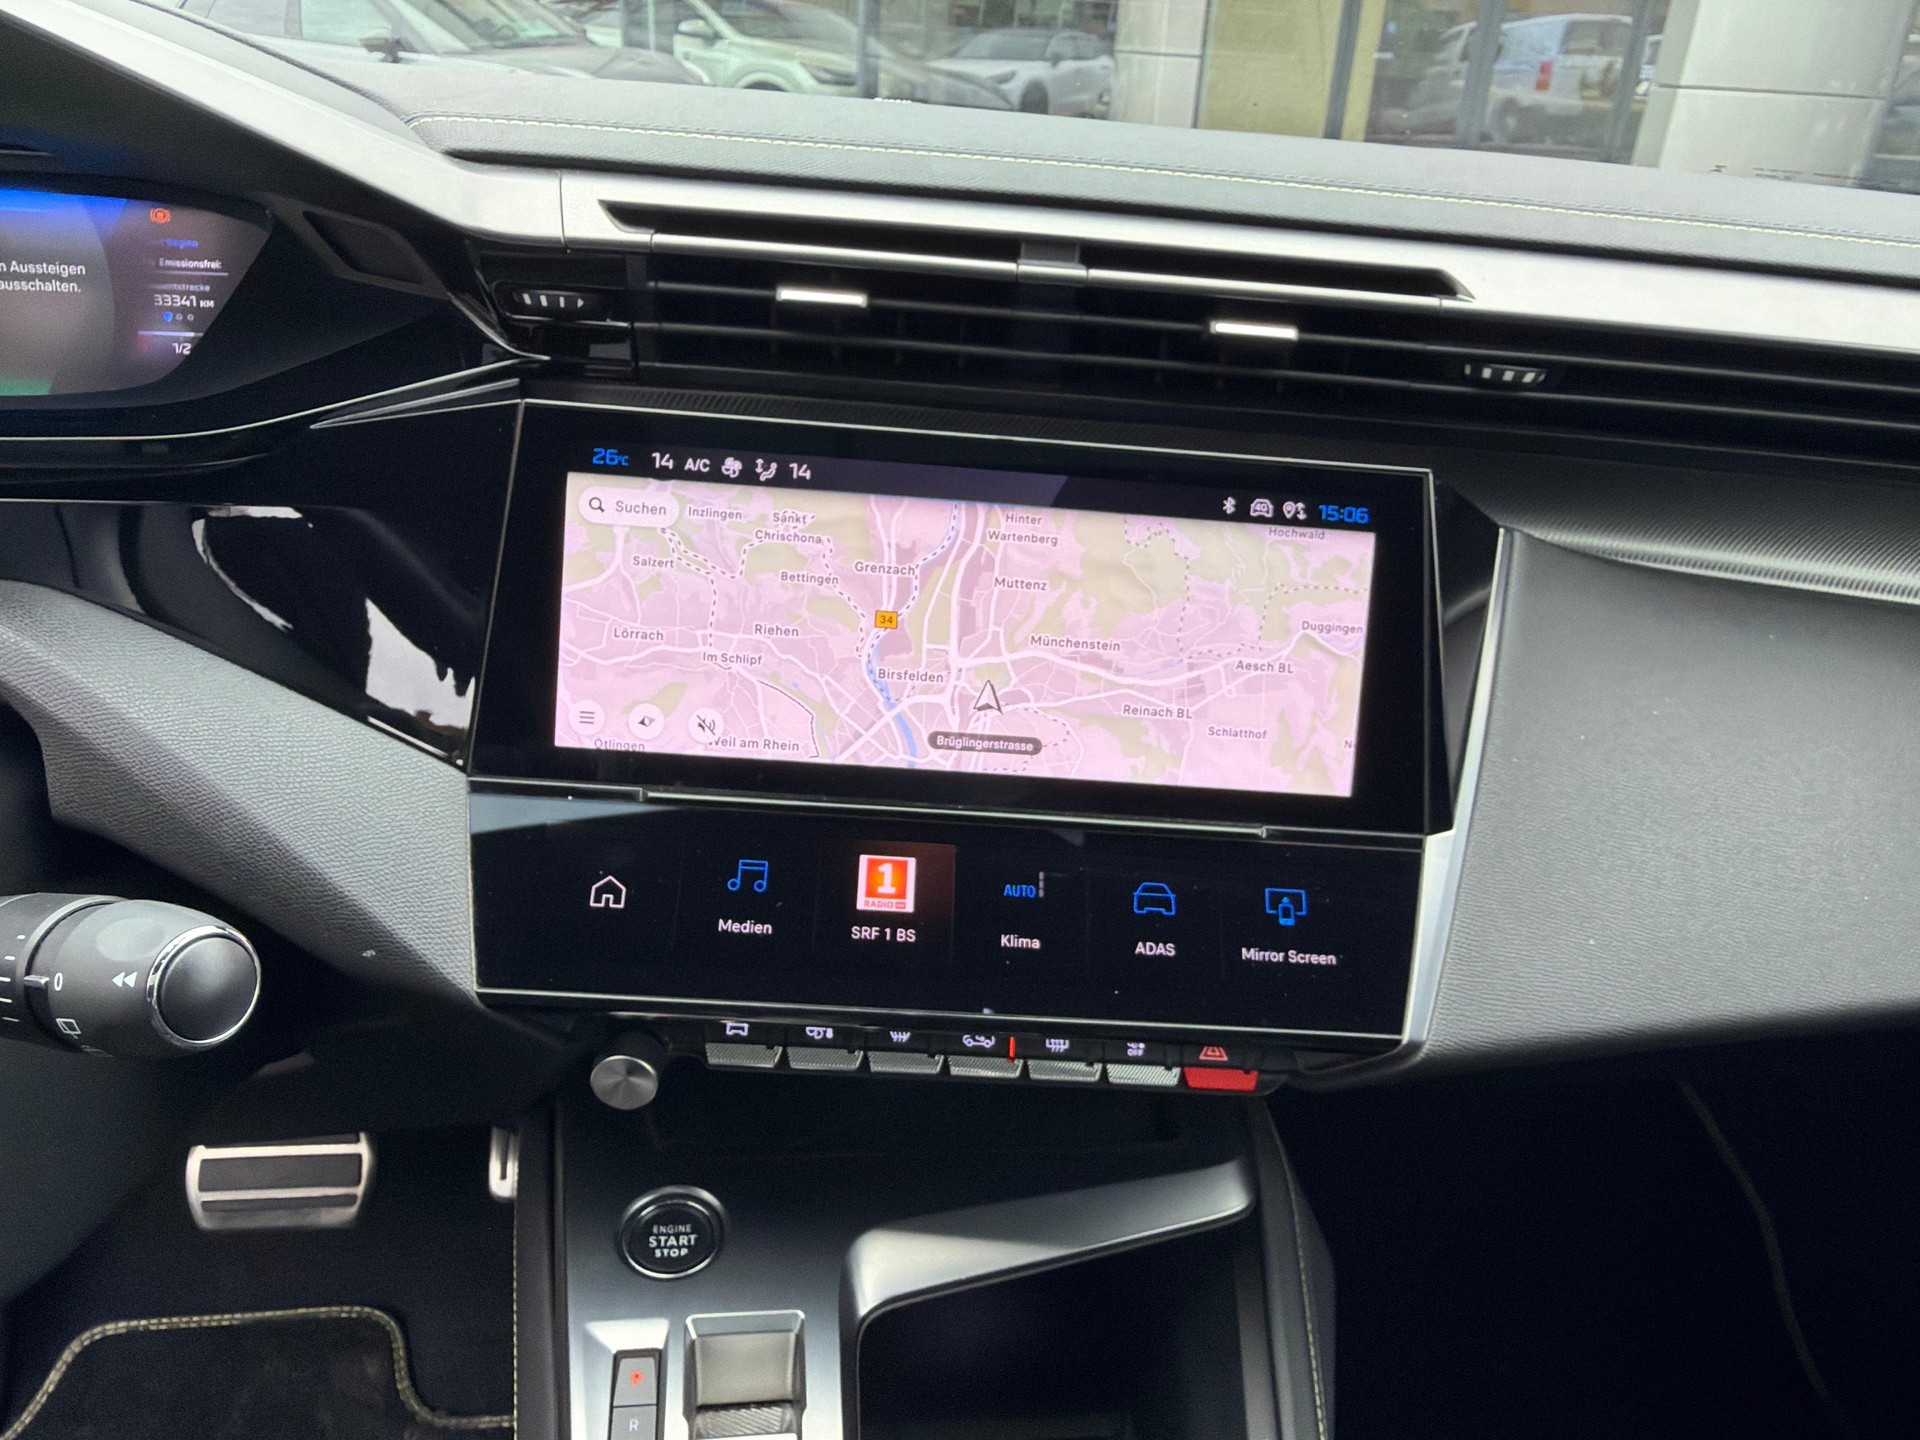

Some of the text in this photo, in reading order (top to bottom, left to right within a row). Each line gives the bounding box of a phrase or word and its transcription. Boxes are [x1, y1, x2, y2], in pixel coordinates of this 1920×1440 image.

[10, 260, 86, 277] Aussteigen
[0, 278, 81, 292] ausschalten.
[153, 294, 197, 307] 33341
[172, 342, 191, 355] 1/2
[652, 452, 710, 472] 14 A/C
[789, 463, 811, 480] 14
[615, 501, 667, 516] Suchen
[688, 506, 742, 521] Inzlingen
[1318, 504, 1370, 524] 15:06
[1005, 513, 1042, 526] Hinter
[755, 530, 822, 545] Chrischona
[988, 530, 1058, 547] Wartenberg
[1269, 527, 1325, 540] Hochwald
[633, 555, 674, 569] Salzert
[855, 562, 915, 576] Grenzach
[781, 571, 839, 586] Bettingen
[994, 577, 1047, 591] Muttenz
[880, 615, 893, 625] 34
[614, 627, 664, 641] Lörrach
[755, 623, 799, 637] Riehen
[1302, 620, 1363, 635] Duggingen
[1031, 635, 1121, 651] Münchenstein
[703, 652, 762, 666] Im Schlipf
[1236, 660, 1294, 674] Aesch BL
[878, 668, 944, 683] Birsfelden
[1123, 704, 1193, 719] Reinach BL
[1208, 726, 1267, 739] Schlatthof
[740, 739, 759, 749] am
[763, 739, 799, 751] Rhein
[936, 735, 1034, 752] Brüglingerstrasse
[877, 863, 896, 894] 1
[1004, 884, 1036, 899] AUTO
[864, 900, 894, 909] RADIO
[718, 919, 772, 935] Medien
[851, 926, 916, 942] SRF 1 BS
[1001, 934, 1041, 949] Klima
[1135, 942, 1176, 956] ADAS
[1241, 948, 1337, 965] Mirror Screen
[652, 1224, 692, 1233] ENGINE
[648, 1234, 698, 1248] START
[655, 1248, 689, 1258] STOP
[630, 1370, 644, 1386] P
[629, 1419, 639, 1431] R
